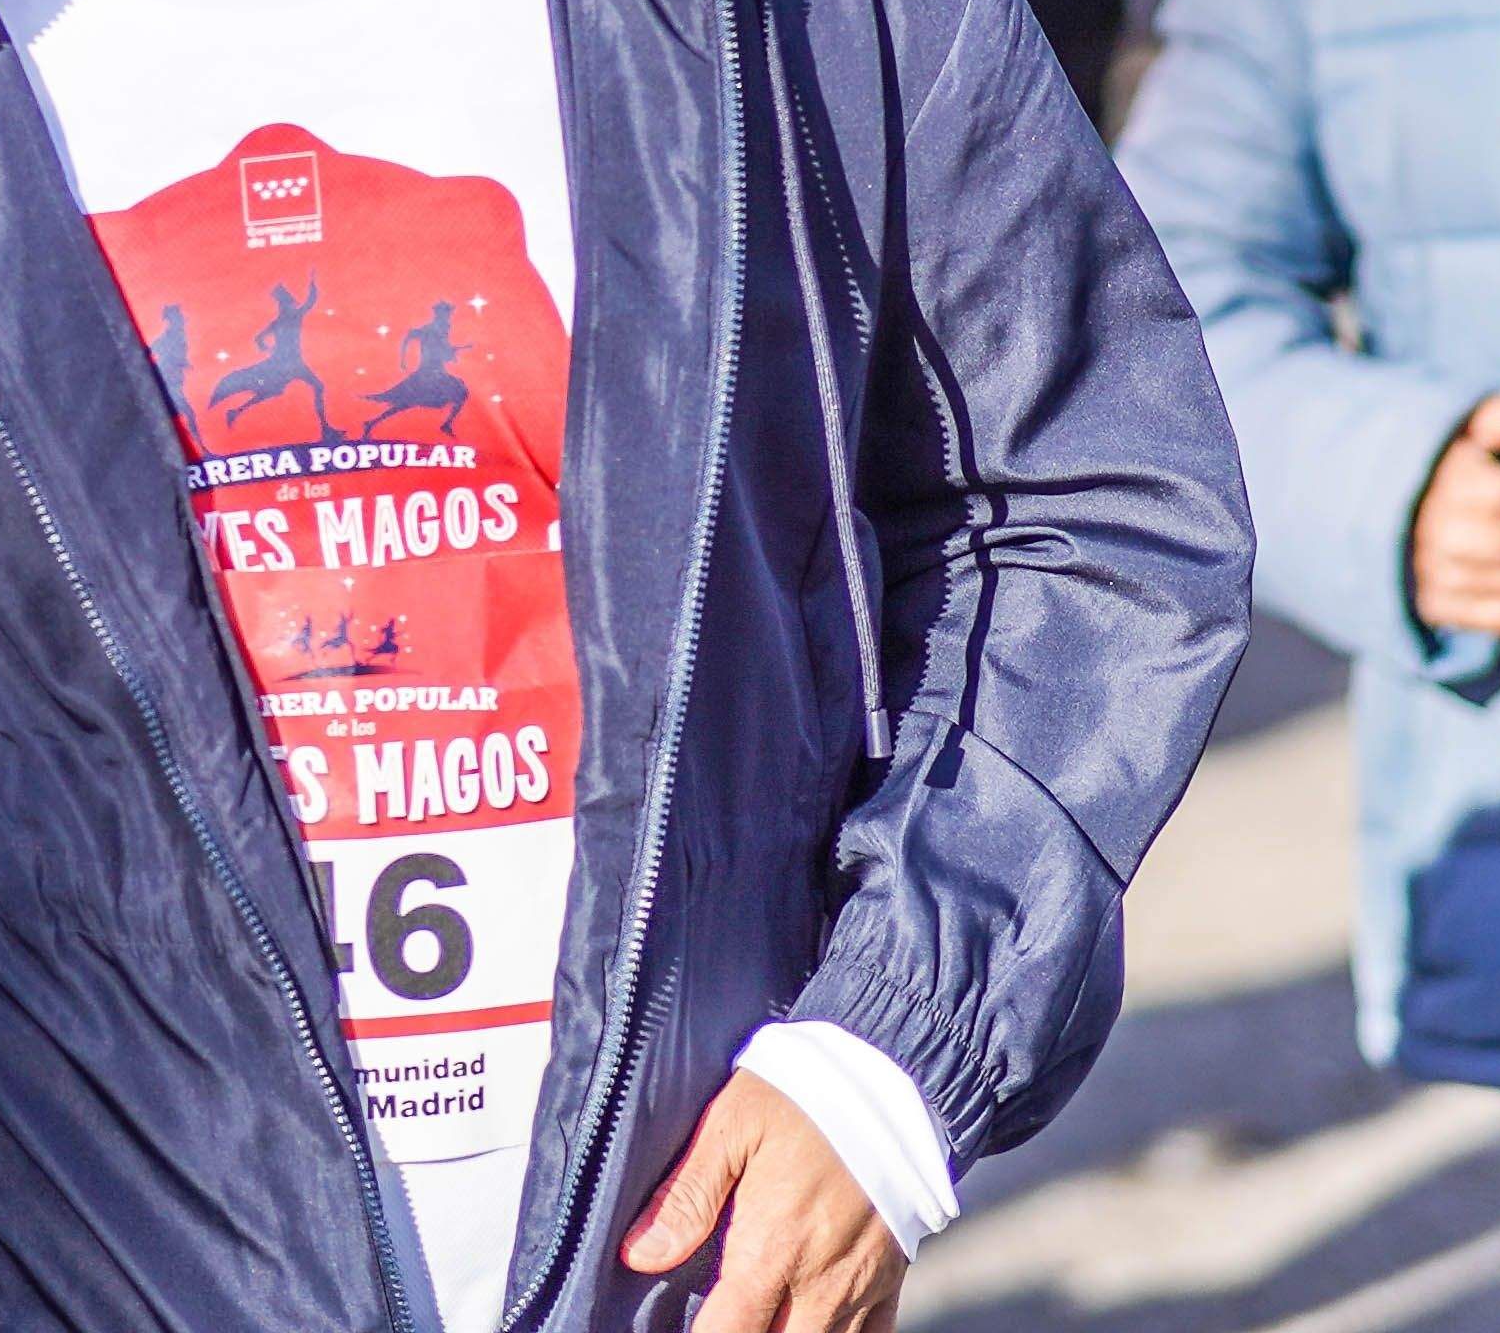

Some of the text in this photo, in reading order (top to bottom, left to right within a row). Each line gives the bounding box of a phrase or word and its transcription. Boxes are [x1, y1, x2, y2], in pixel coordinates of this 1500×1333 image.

[310, 444, 477, 472] POPULAR
[276, 481, 332, 503] de los
[313, 483, 519, 570] MAGOS
[256, 687, 499, 717] RERA POPULAR
[326, 719, 377, 737] de los
[352, 725, 550, 826] MAGOS
[366, 1086, 486, 1120] Madrid
